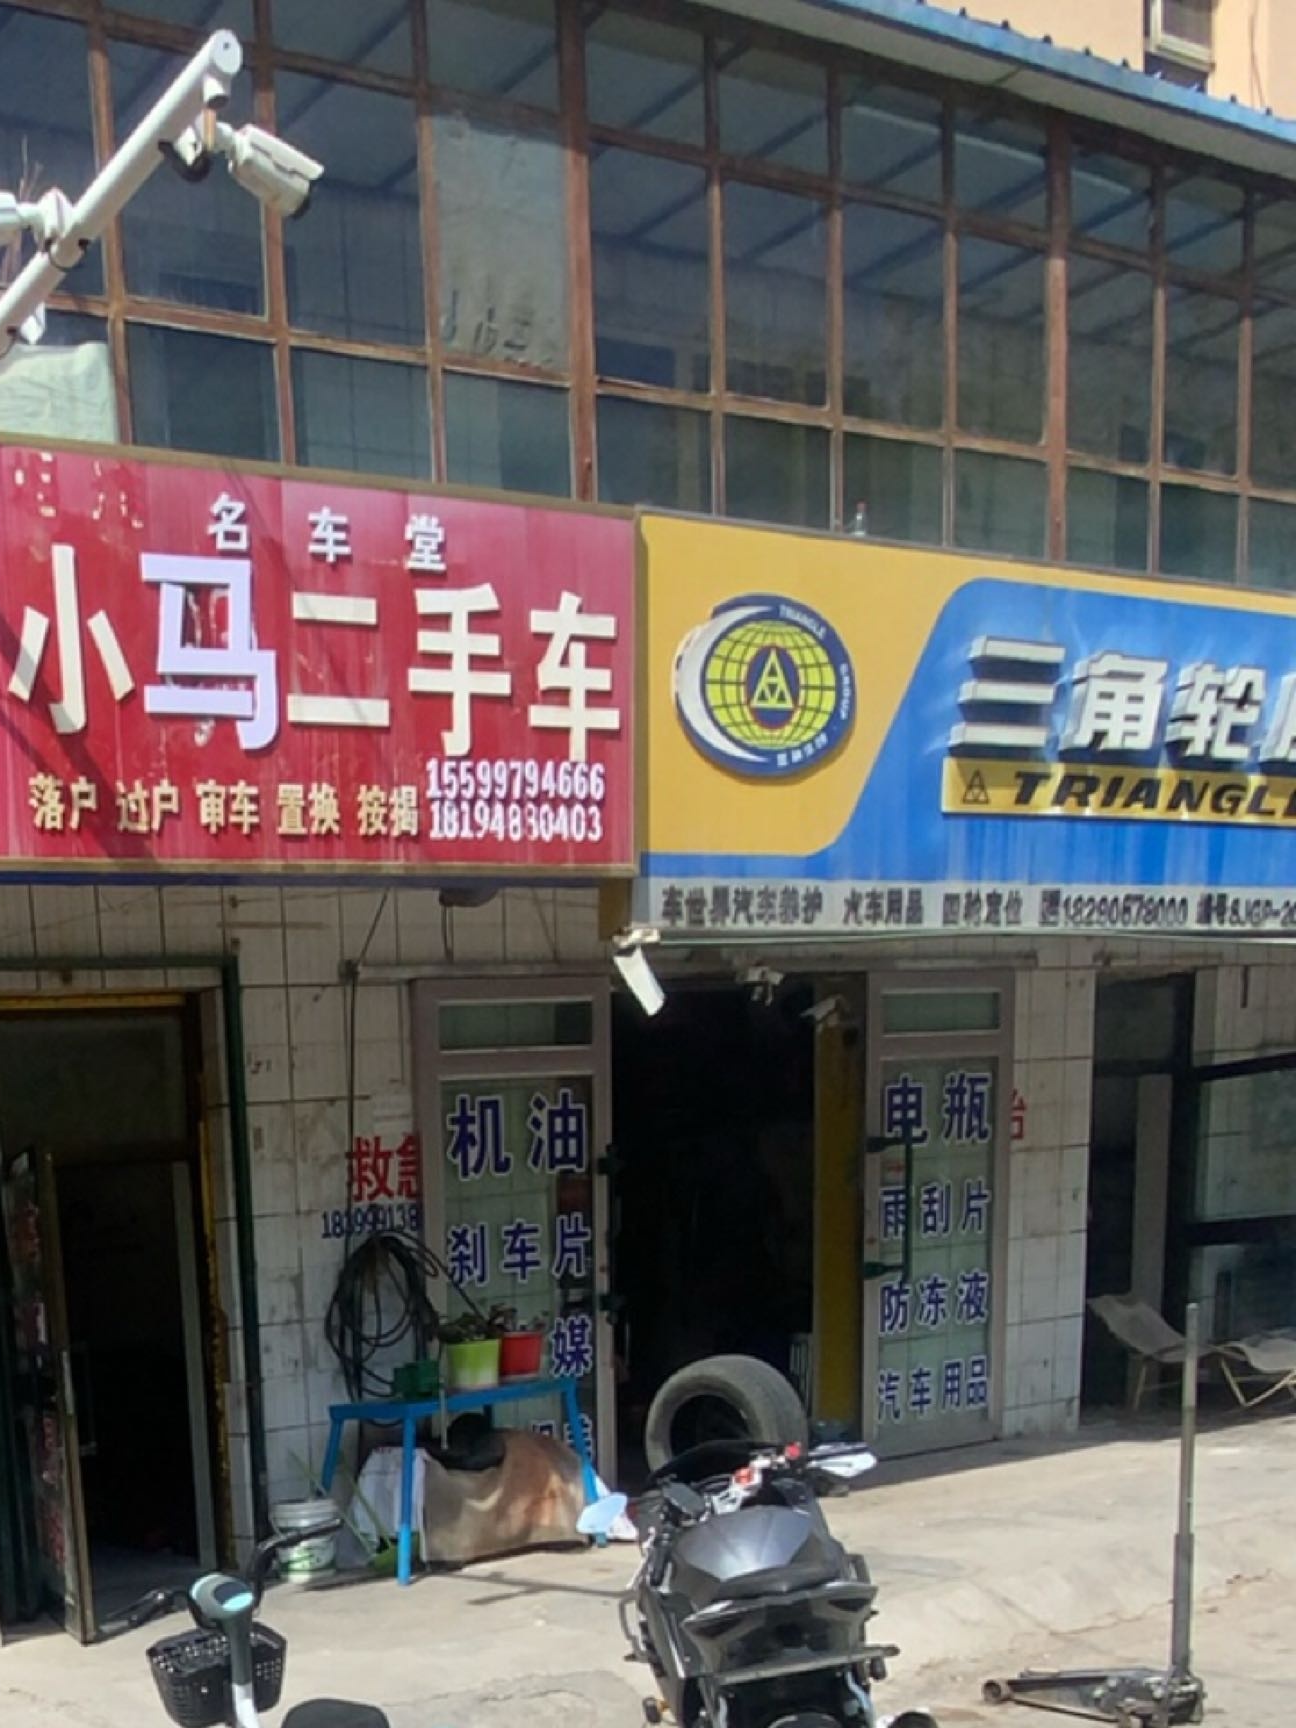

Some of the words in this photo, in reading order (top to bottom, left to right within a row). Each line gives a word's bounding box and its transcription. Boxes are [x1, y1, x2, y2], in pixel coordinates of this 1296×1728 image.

[208, 493, 447, 573] 名车堂
[8, 543, 620, 763] 小马二手车
[28, 771, 98, 831] 落户
[115, 778, 180, 834] 过户
[195, 779, 261, 835] 审车
[277, 782, 340, 837] 置换
[426, 757, 605, 800] 15599794666
[447, 1088, 590, 1181] 机油
[884, 1071, 993, 1147] 电瓶
[879, 1176, 992, 1240] 雨刮片
[447, 1213, 593, 1288] 刹车片
[877, 1272, 990, 1337] 防冻液
[876, 1357, 990, 1422] 汽车用品
